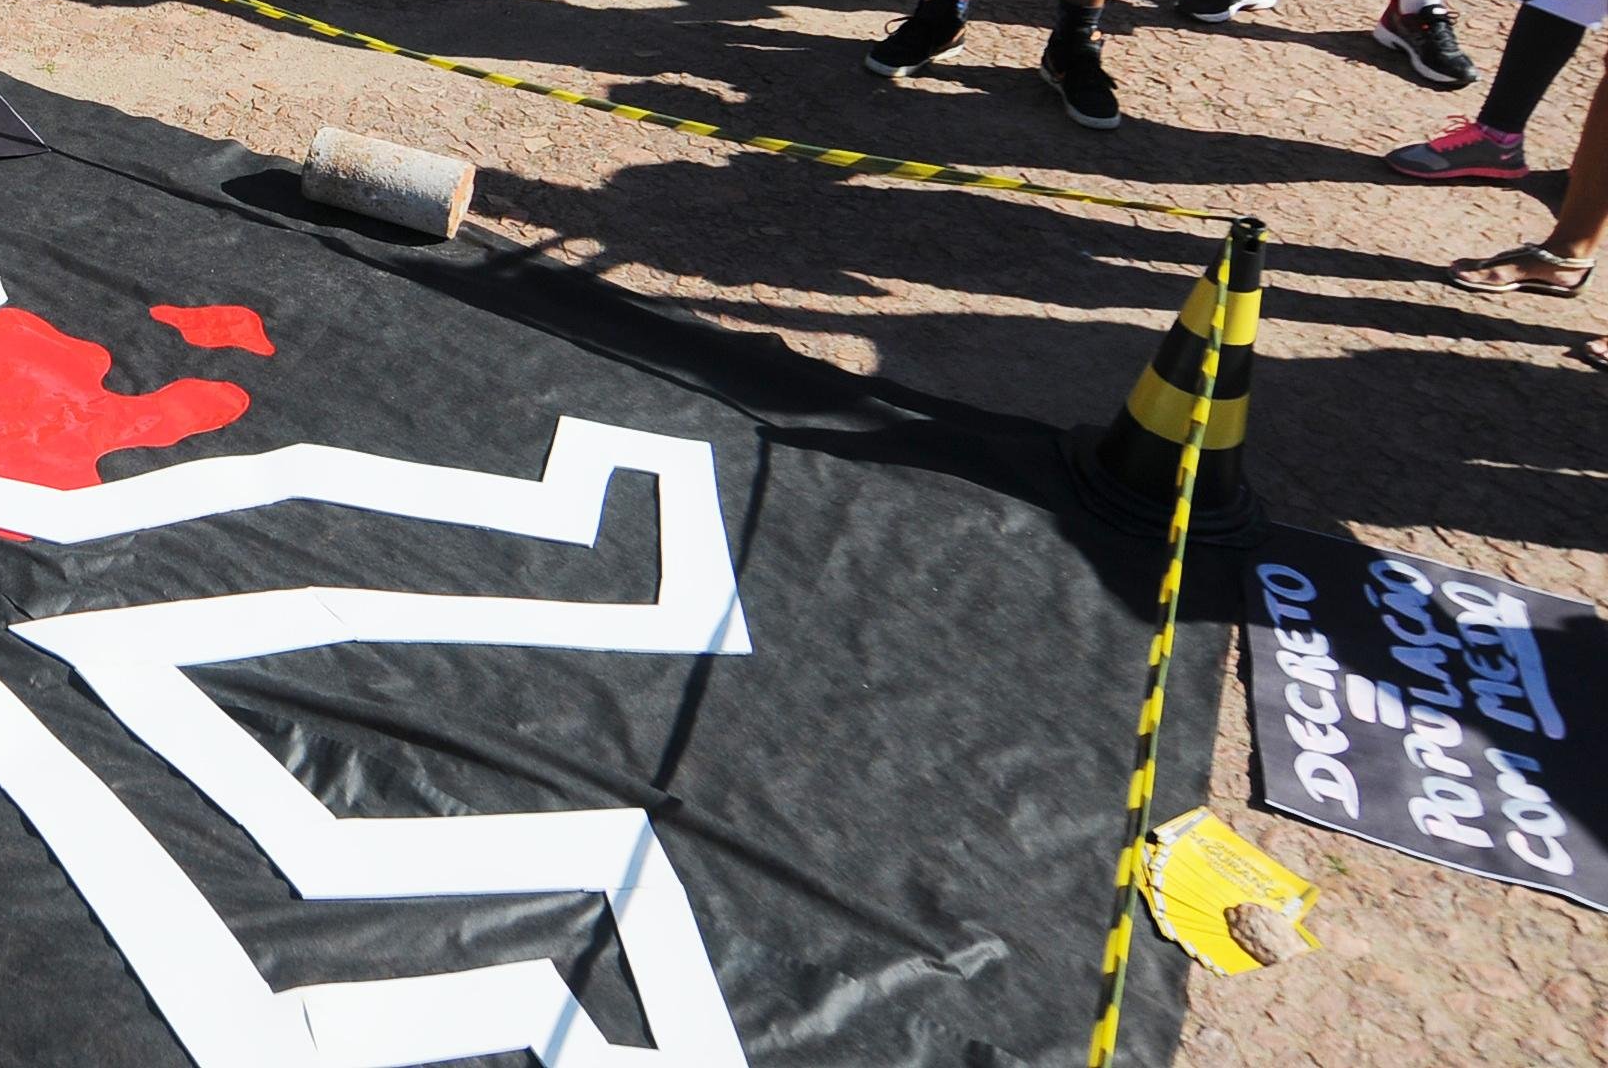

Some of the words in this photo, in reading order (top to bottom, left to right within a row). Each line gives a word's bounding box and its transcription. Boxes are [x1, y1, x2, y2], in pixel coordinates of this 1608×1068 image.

[1257, 563, 1359, 820] DECRETO
[1365, 560, 1494, 848] POPULAÇÃO
[1441, 580, 1534, 731] MEDO
[1485, 747, 1574, 876] COM
